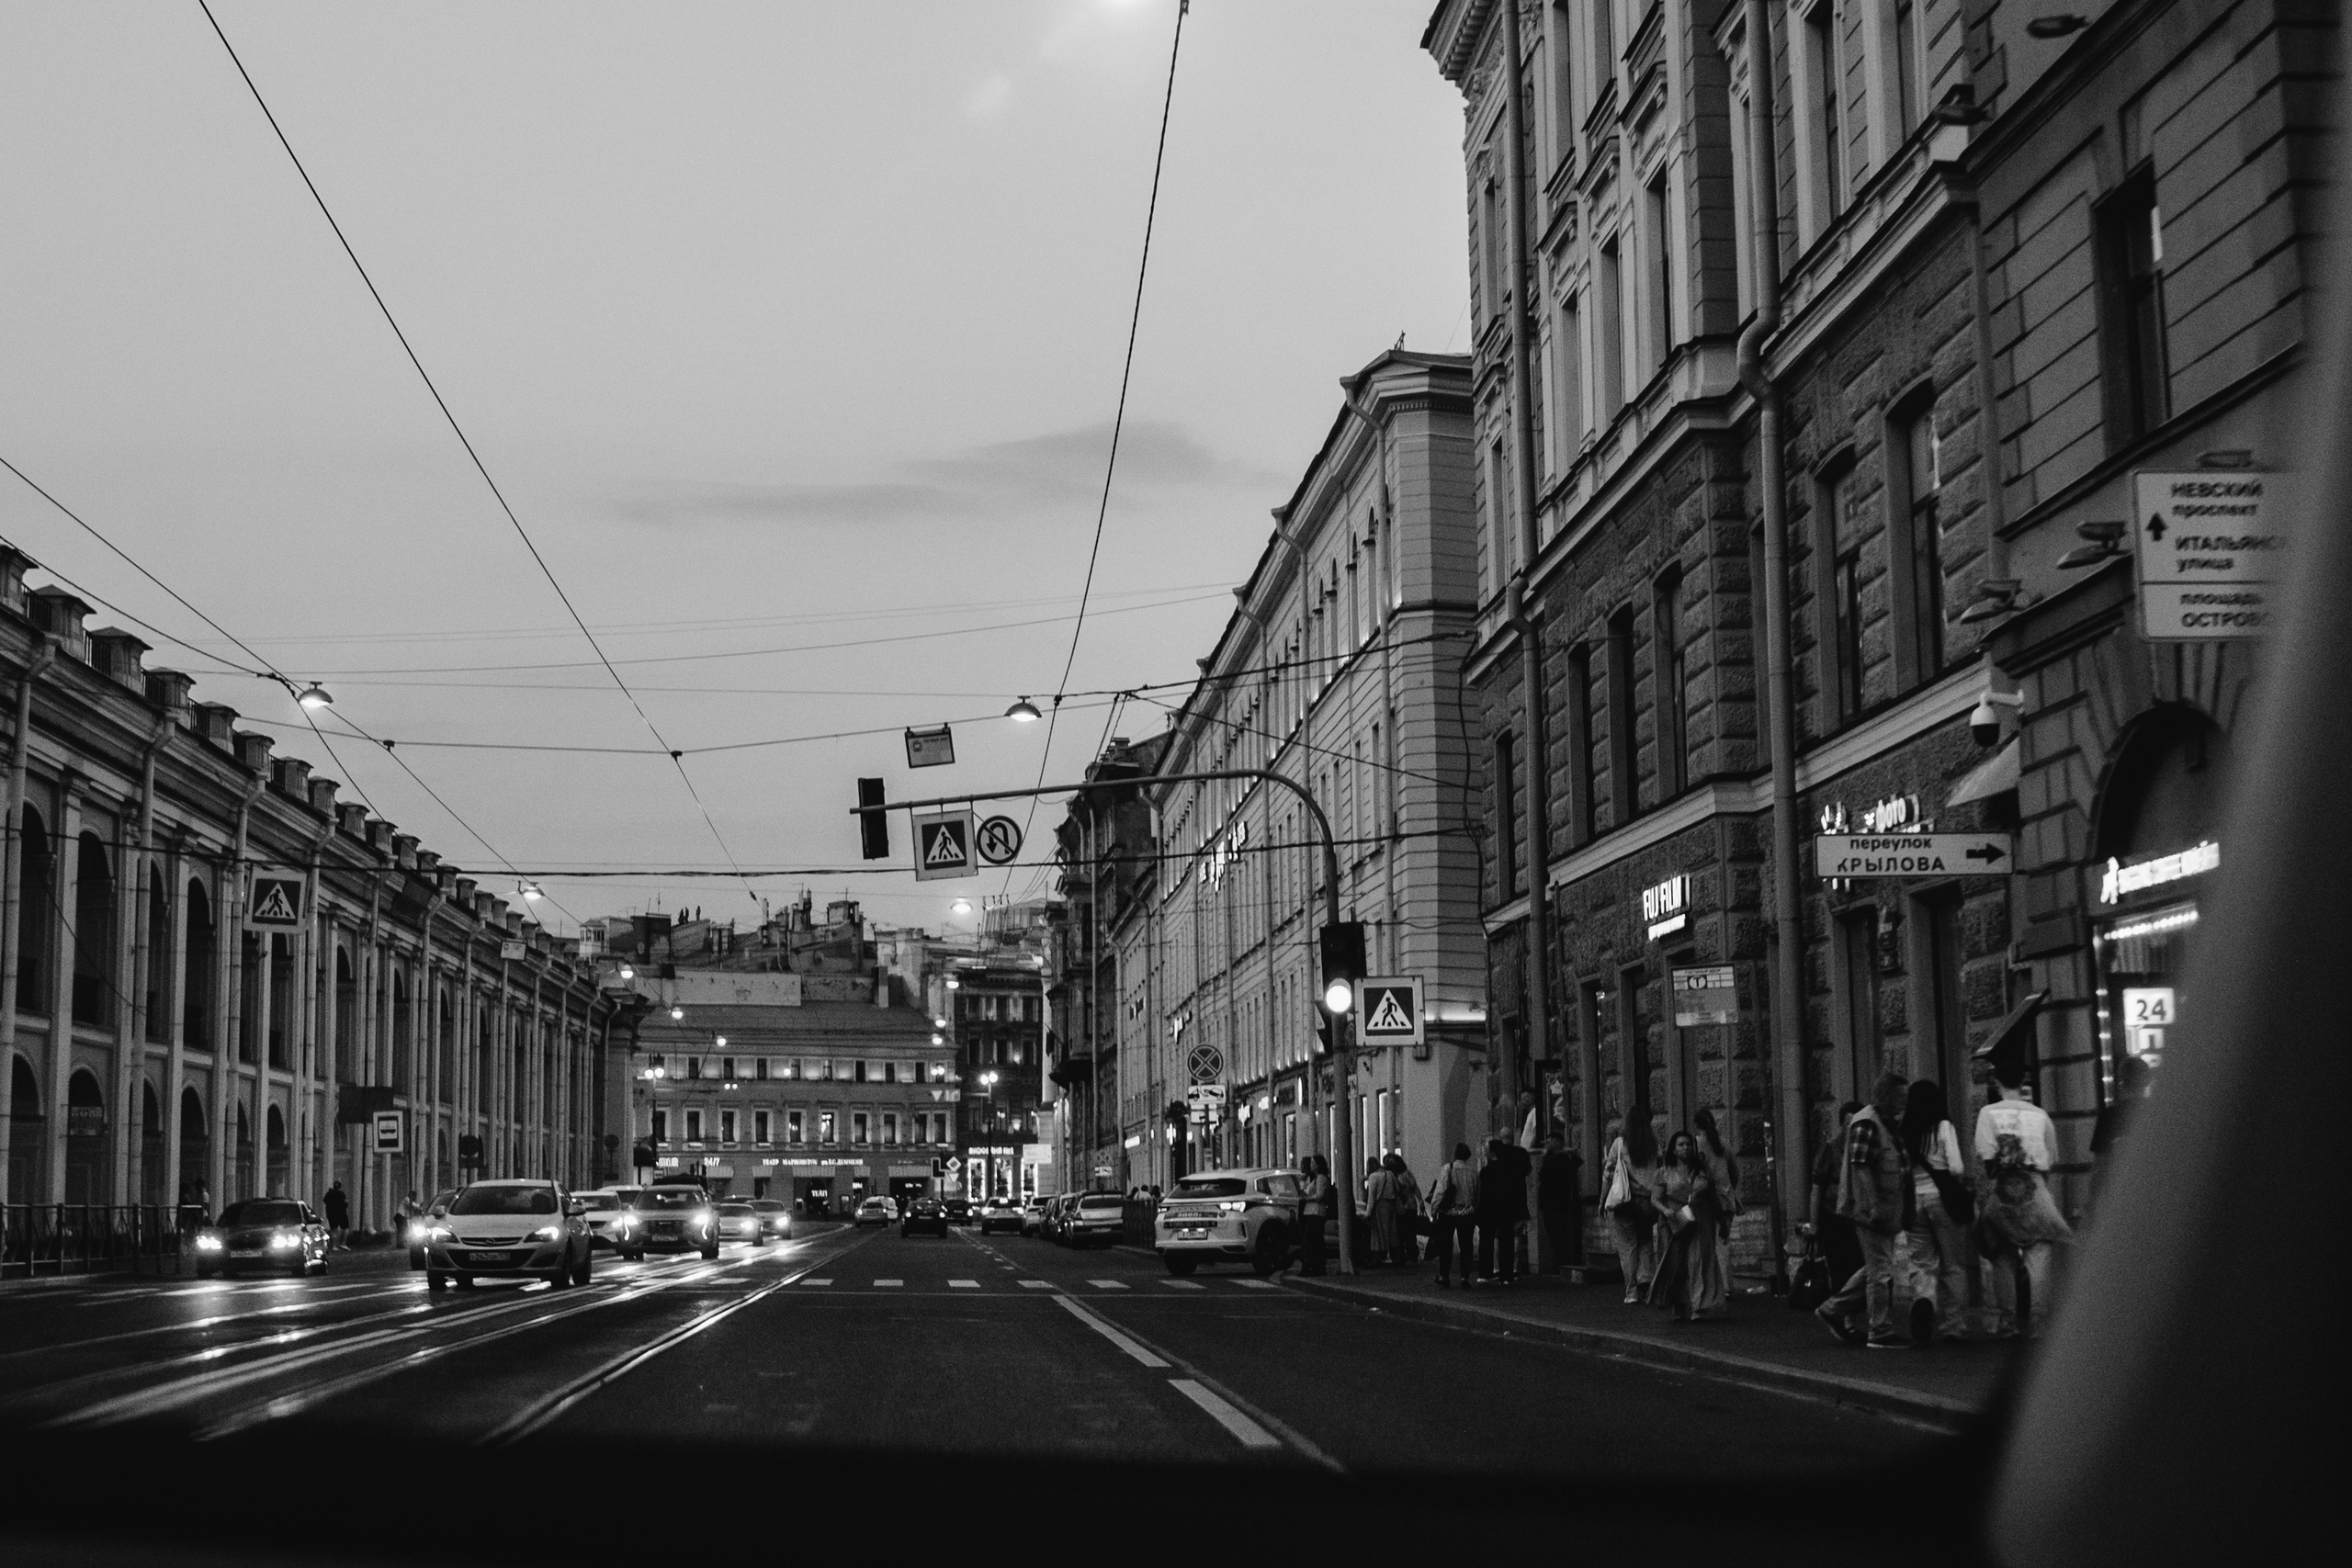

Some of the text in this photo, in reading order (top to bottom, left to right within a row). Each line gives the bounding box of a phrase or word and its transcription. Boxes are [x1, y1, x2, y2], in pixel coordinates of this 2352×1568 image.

[2171, 479, 2263, 498] НЕВСКИЙ
[2172, 503, 2258, 519] проспект
[2177, 558, 2234, 573] улица
[1849, 837, 1932, 852] переулок
[1838, 856, 1945, 872] КРЫЛОВА
[2136, 998, 2166, 1021] 24
